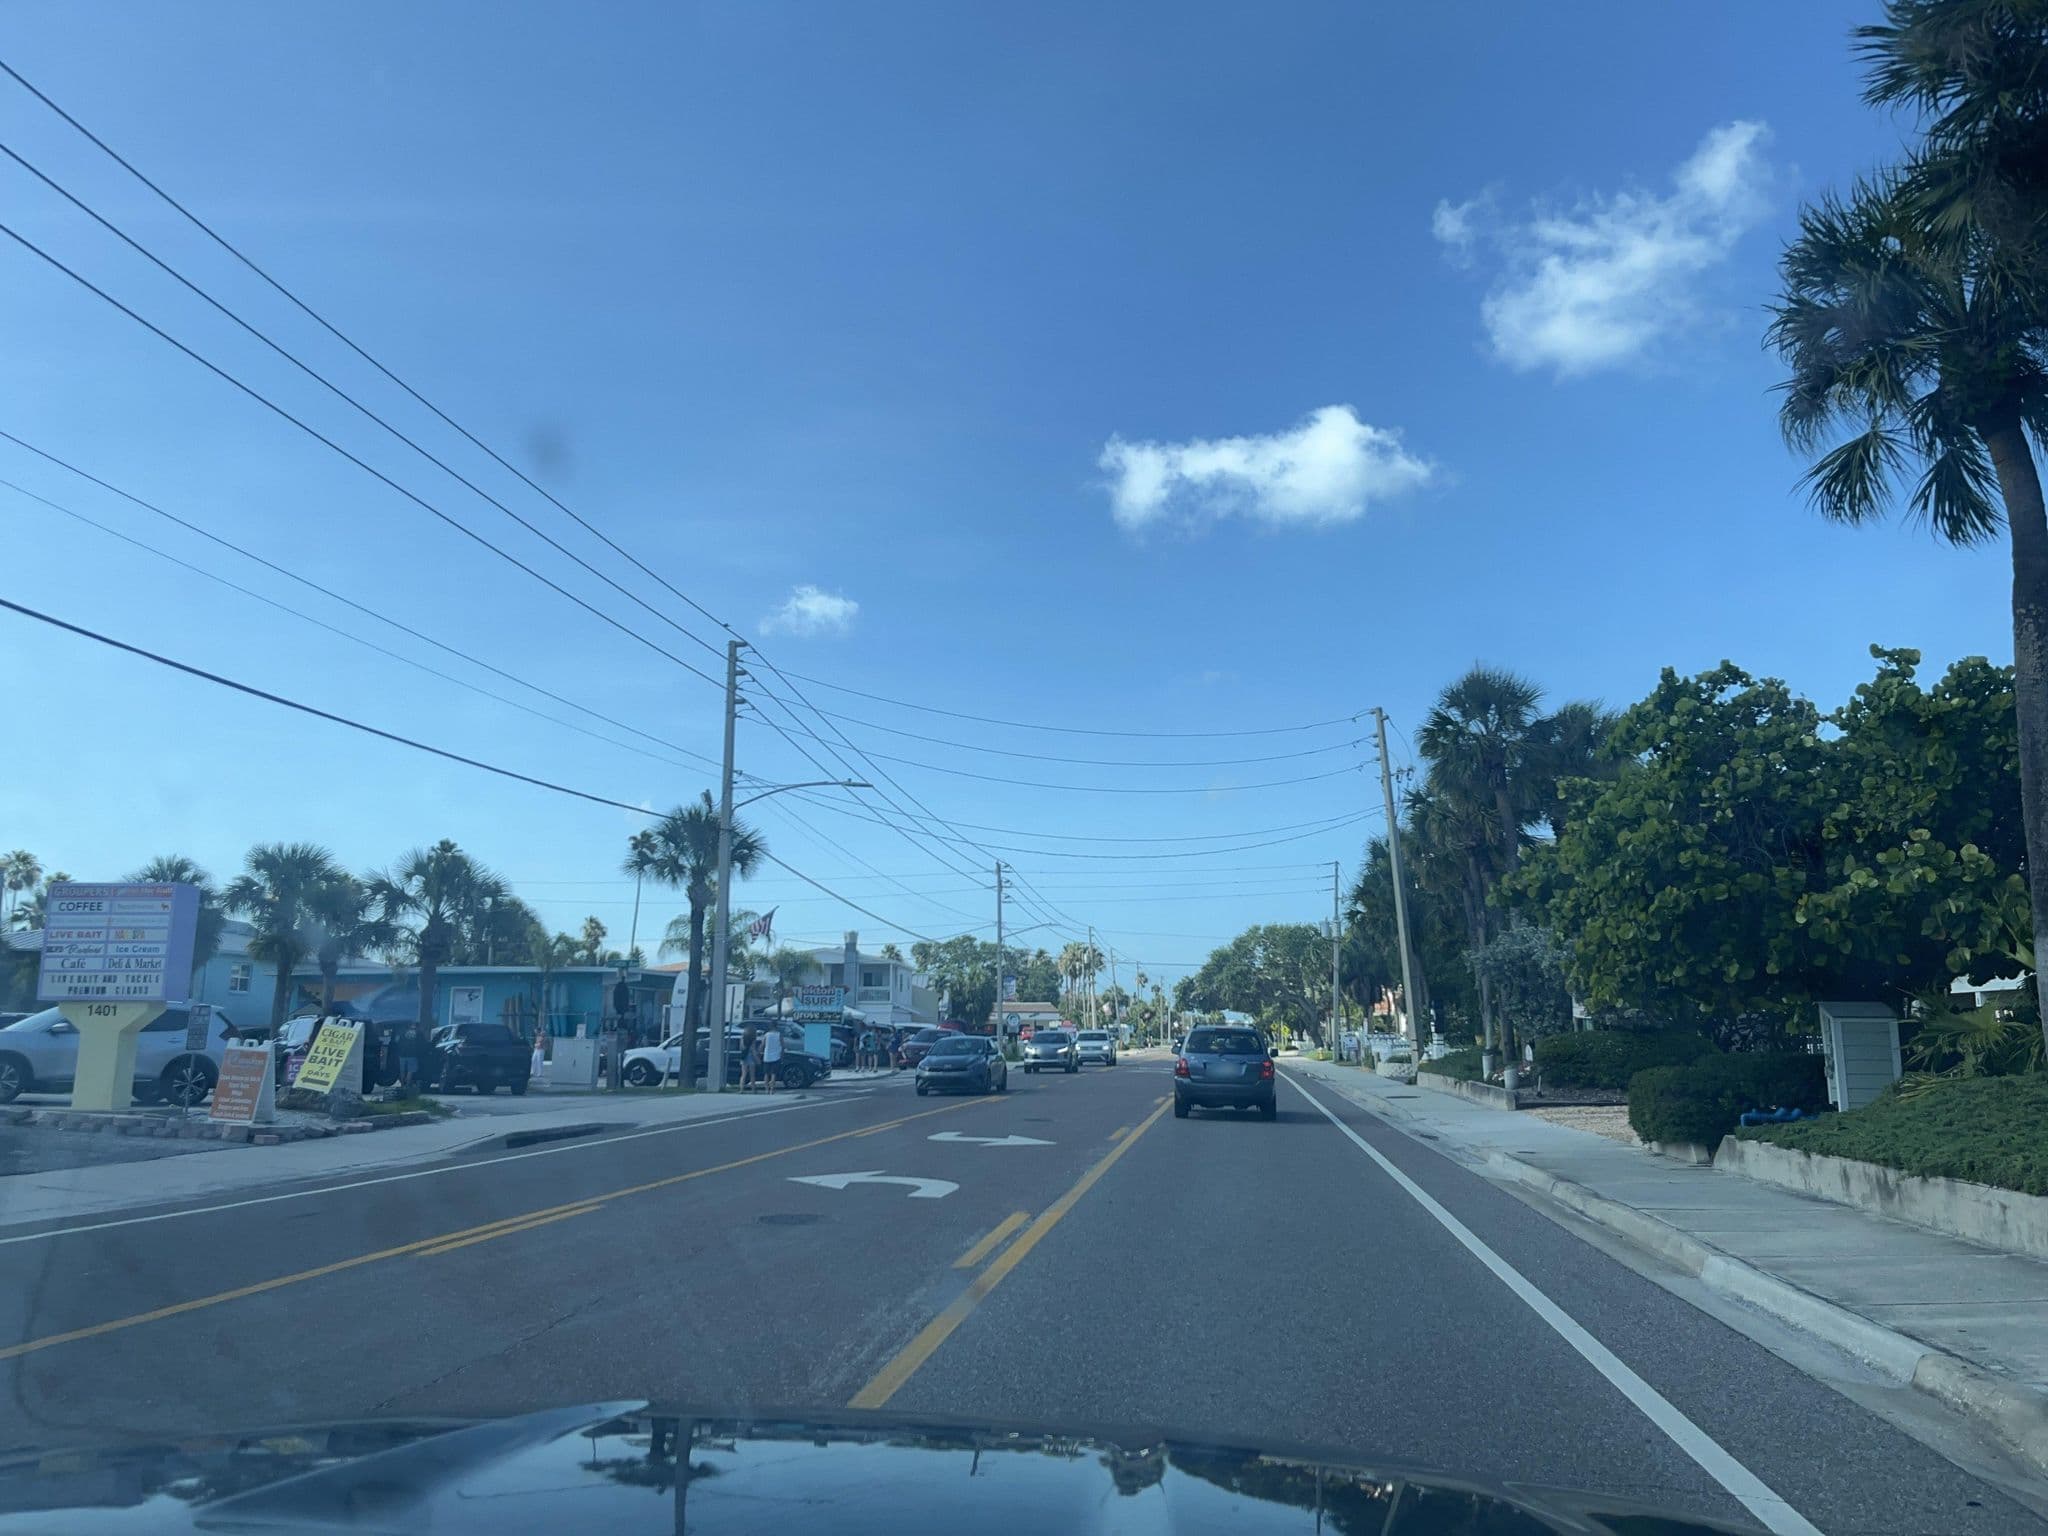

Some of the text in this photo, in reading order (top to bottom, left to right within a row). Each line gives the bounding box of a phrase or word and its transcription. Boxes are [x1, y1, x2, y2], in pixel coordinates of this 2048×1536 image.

[58, 901, 104, 912] COFFEE
[49, 931, 103, 939] LIVE BAIT
[115, 945, 160, 953] Ice Cream
[108, 959, 162, 969] Deli & Market
[51, 975, 160, 983] LIVE BAIT AND TACKLE
[68, 986, 107, 995] PREMIUM
[804, 996, 835, 1005] SURF
[87, 1005, 117, 1016] 1401
[321, 1028, 354, 1042] CIGAR
[314, 1046, 345, 1058] LIVE
[308, 1055, 343, 1068] BAIT
[307, 1070, 331, 1078] DAYS
